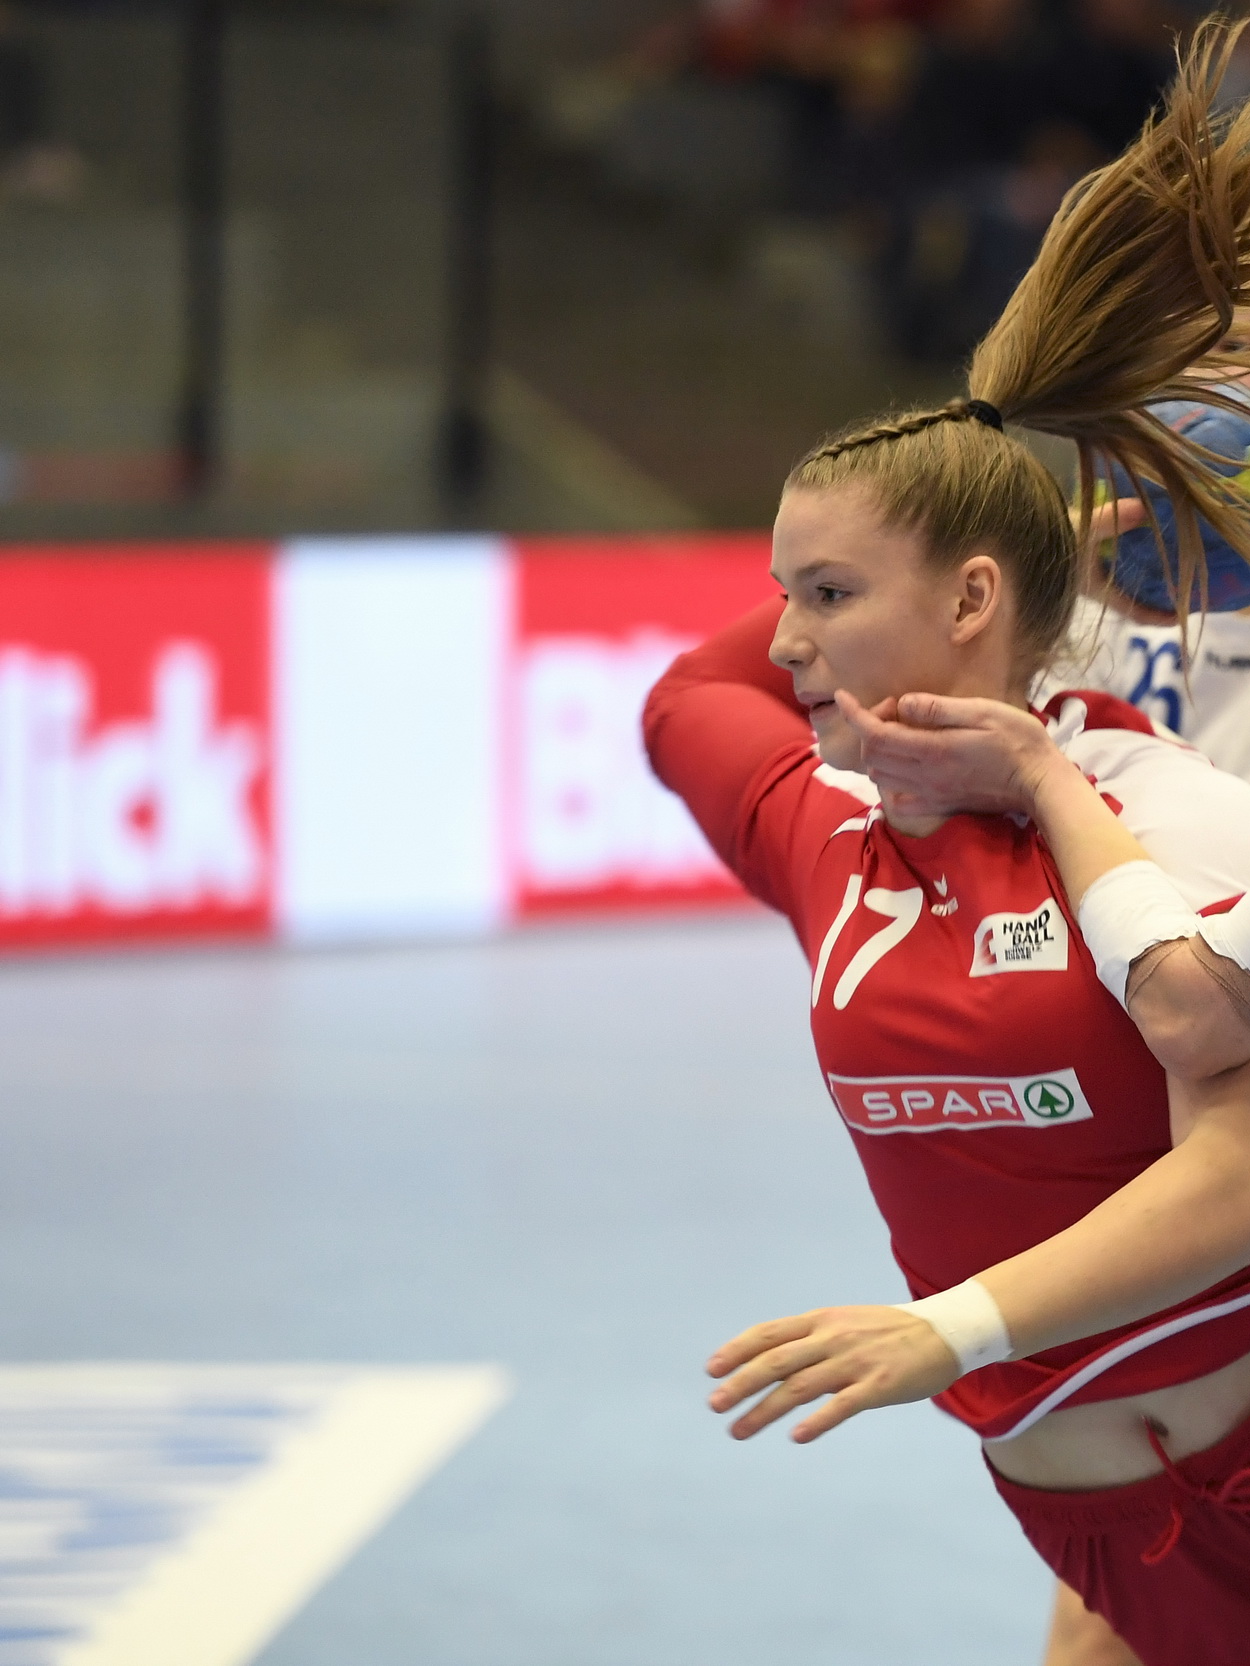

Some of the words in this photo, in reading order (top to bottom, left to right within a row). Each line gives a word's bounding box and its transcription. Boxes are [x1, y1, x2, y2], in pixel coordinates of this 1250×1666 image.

[1003, 909, 1051, 935] HAND
[1012, 924, 1054, 946] BALL
[811, 873, 924, 1011] 17
[861, 1089, 1018, 1122] SPAR
